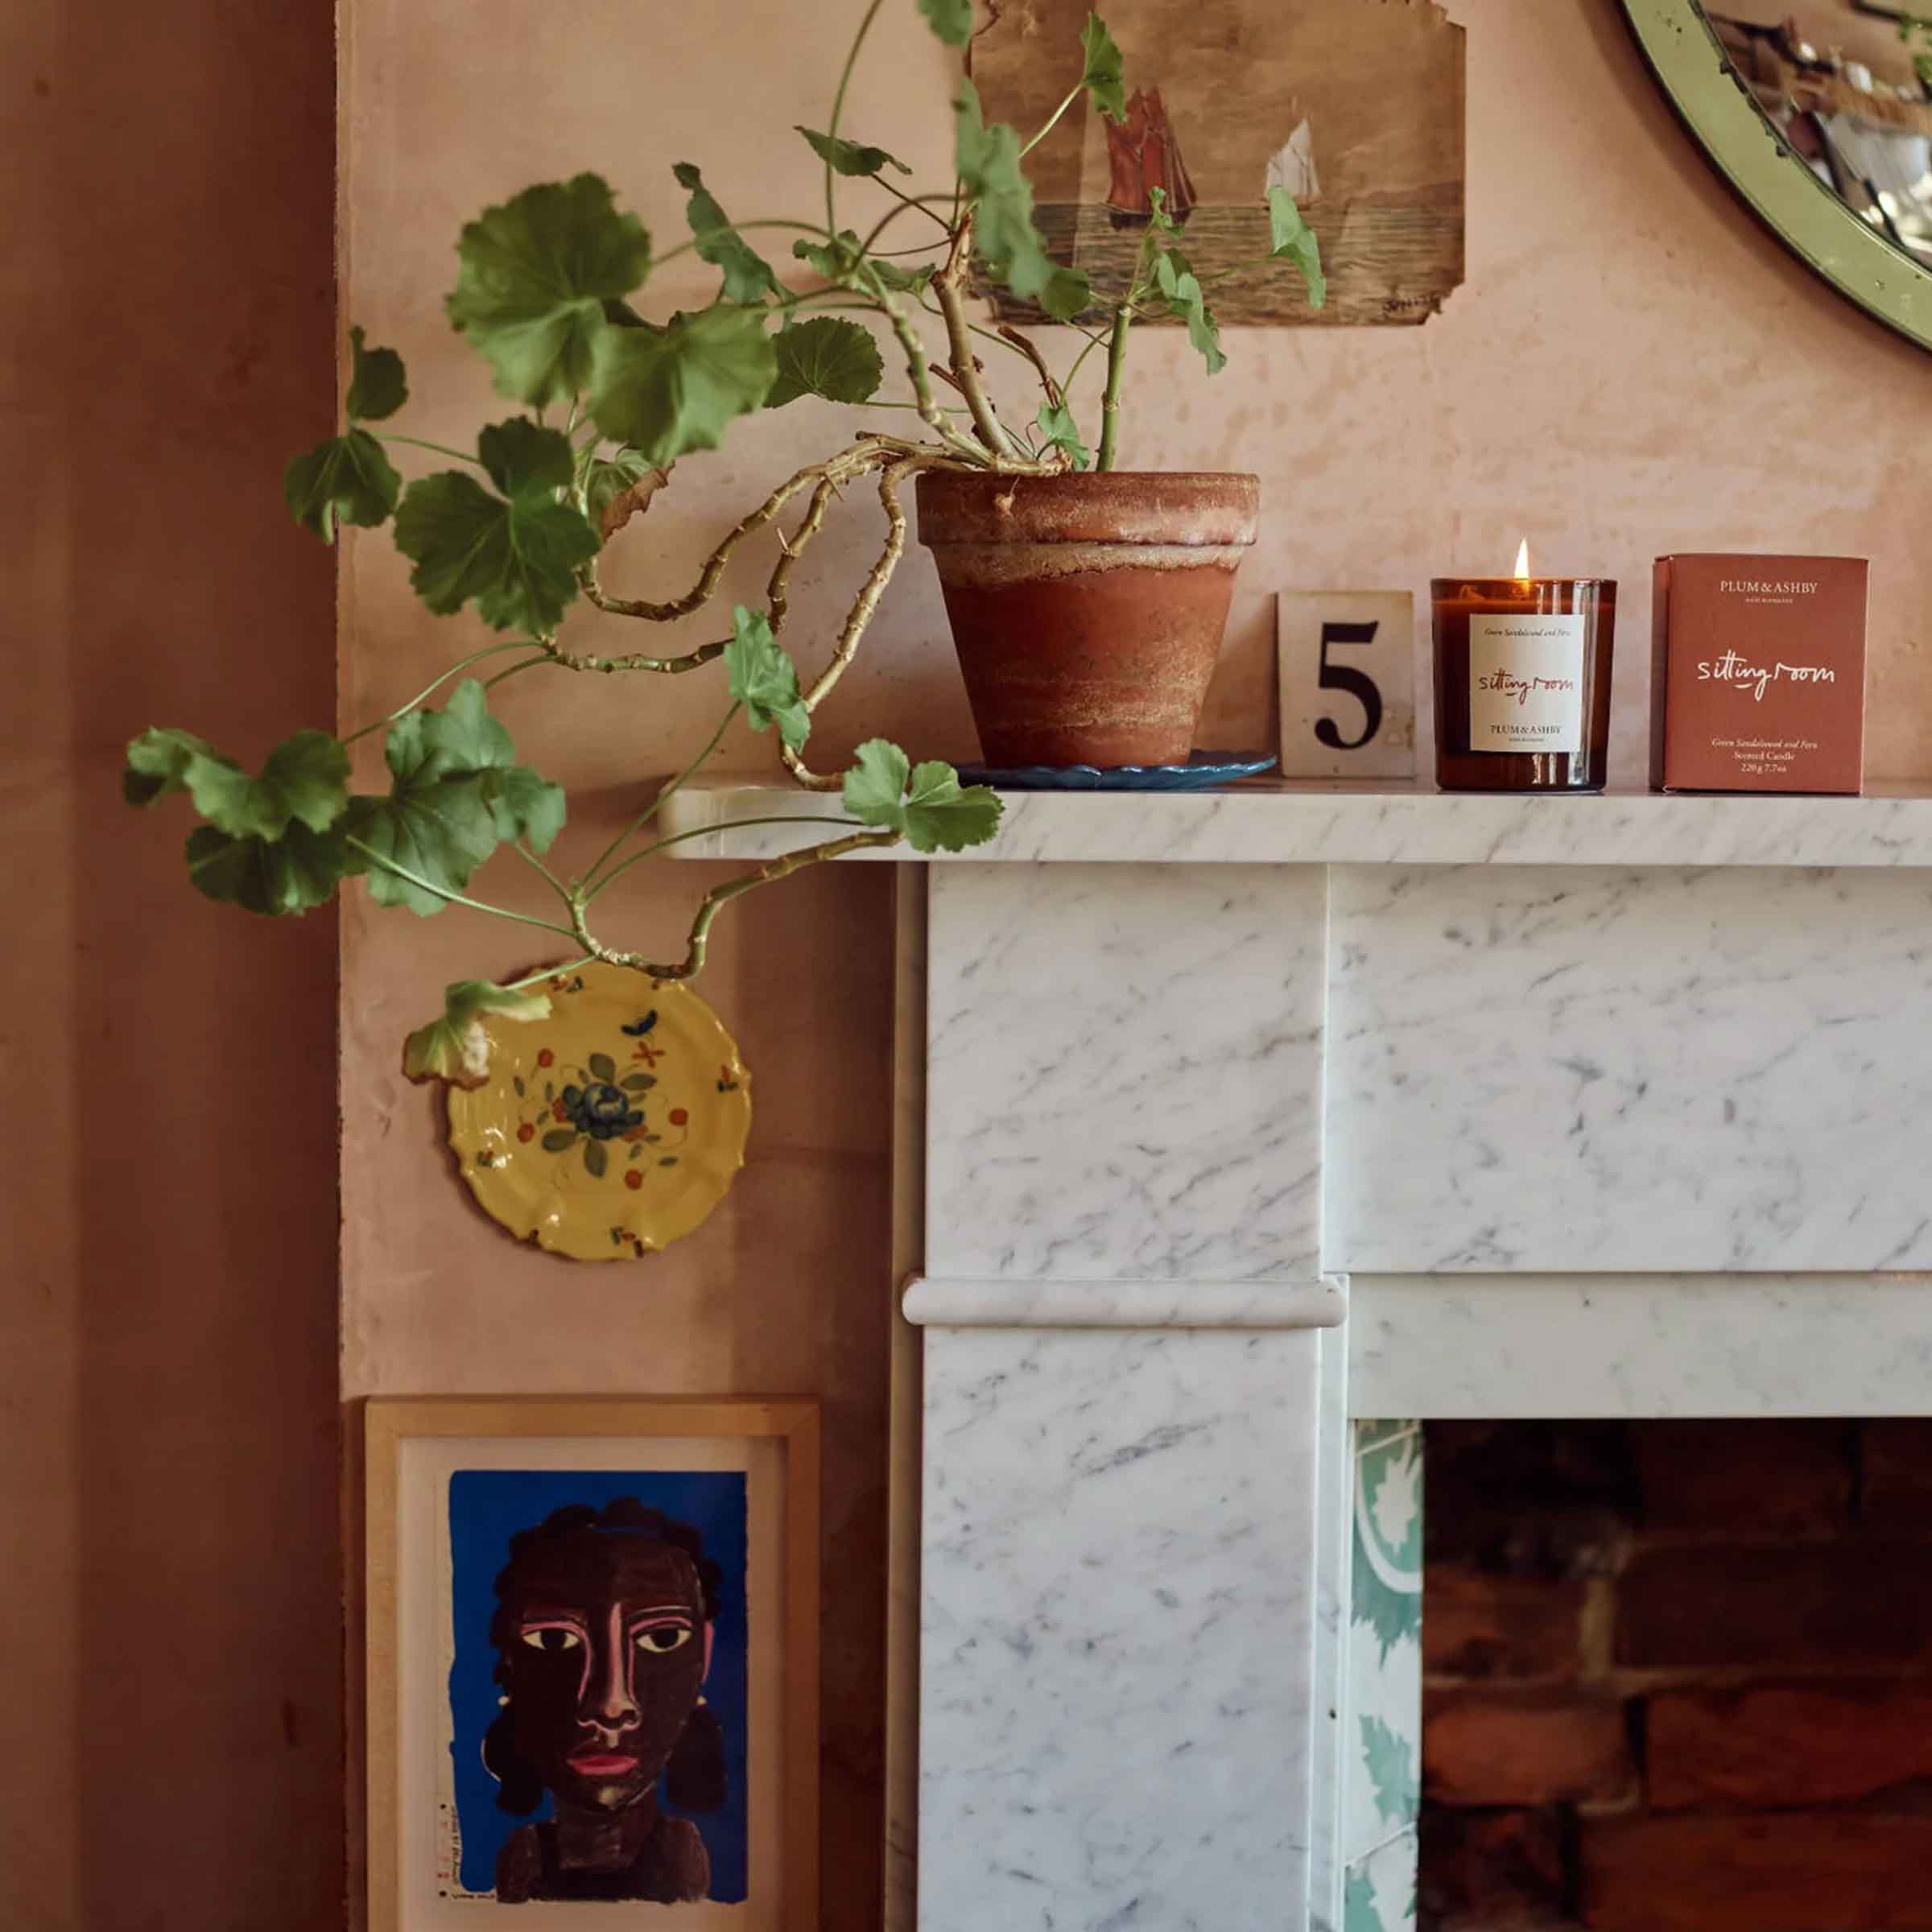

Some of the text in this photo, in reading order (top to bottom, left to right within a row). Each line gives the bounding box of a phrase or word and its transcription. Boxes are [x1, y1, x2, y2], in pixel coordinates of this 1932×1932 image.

[1315, 619, 1383, 751] 5
[1479, 668, 1574, 706] sitting room
[1697, 648, 1836, 703] sitting room
[1766, 750, 1795, 761] Candle
